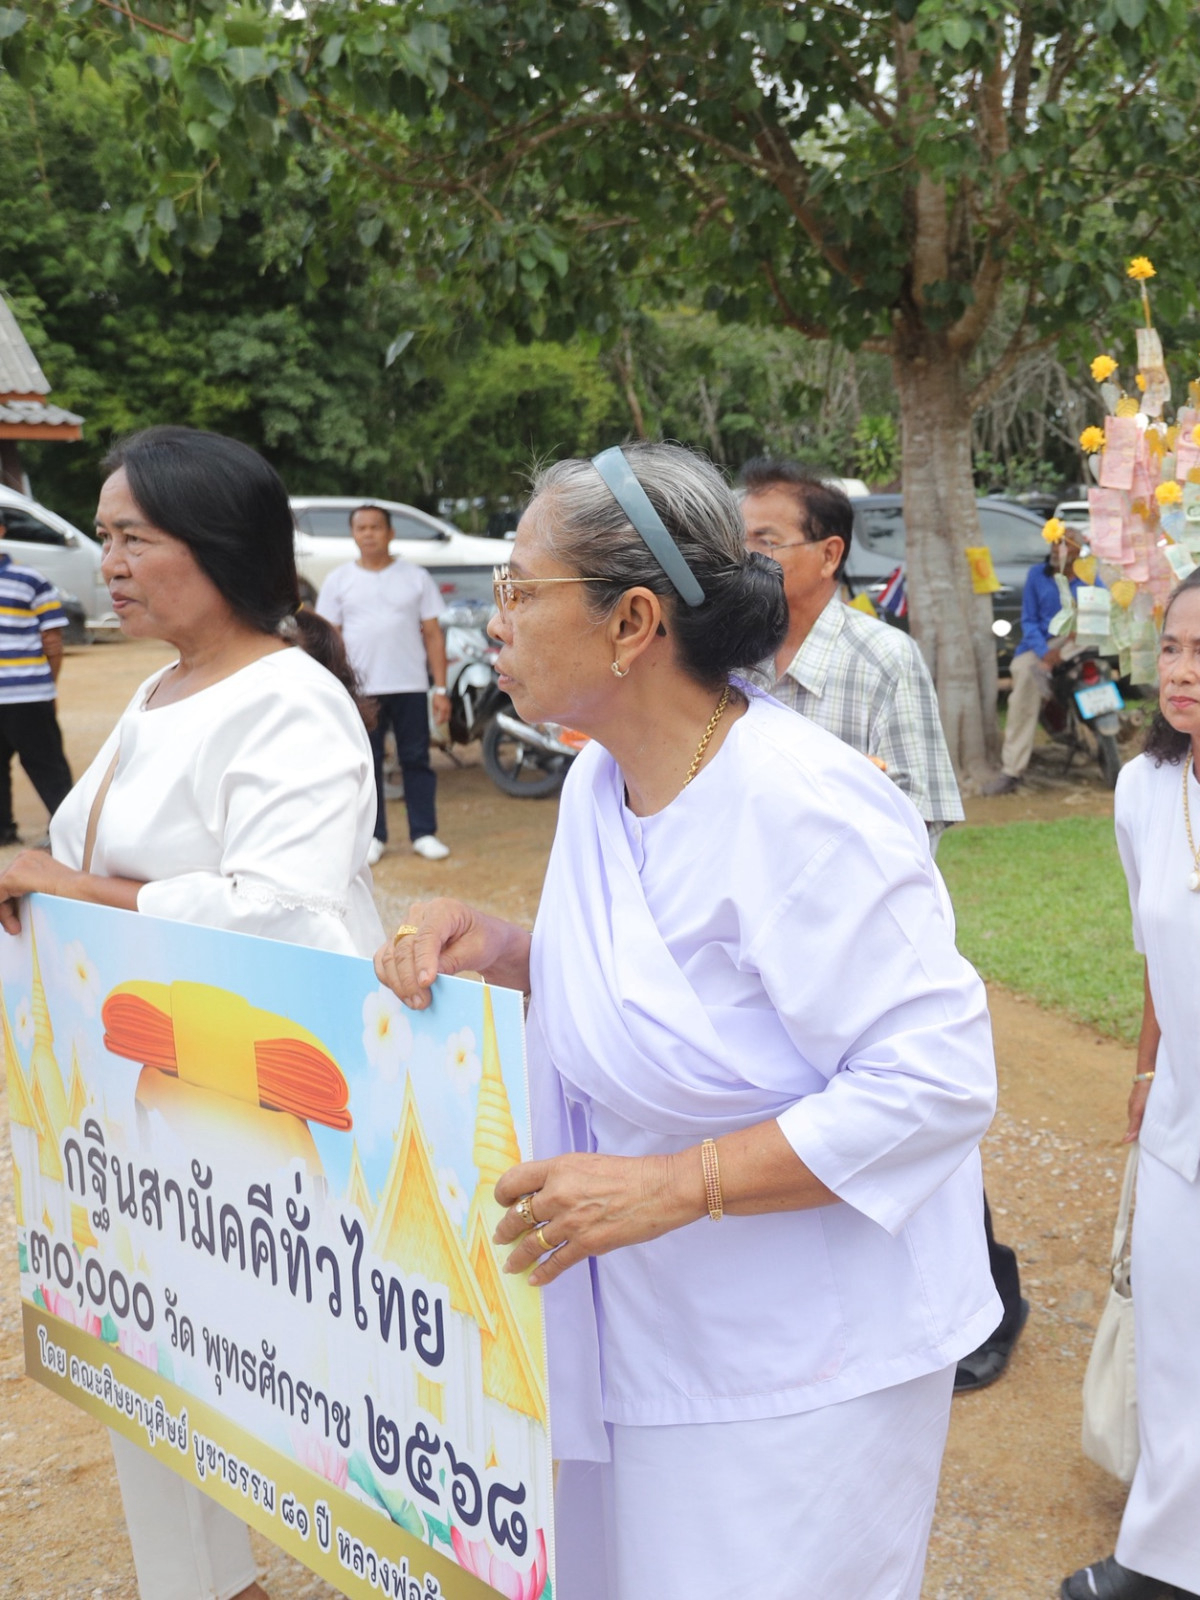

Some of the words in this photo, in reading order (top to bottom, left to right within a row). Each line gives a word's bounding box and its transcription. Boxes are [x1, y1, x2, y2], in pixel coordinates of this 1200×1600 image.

[64, 1118, 446, 1368] กฐินสามัคคีทั่วไทย
[38, 1328, 66, 1373] โดย
[71, 1359, 187, 1449] คณะศิษยานุศิษย์
[194, 1434, 274, 1511] บูชาธรรม
[281, 1492, 308, 1535] ๘๑
[316, 1504, 330, 1549] ปี
[164, 1287, 195, 1357] วัด
[203, 1327, 351, 1449] พุทธศักราช
[363, 1394, 528, 1557] ๒๕๖๘
